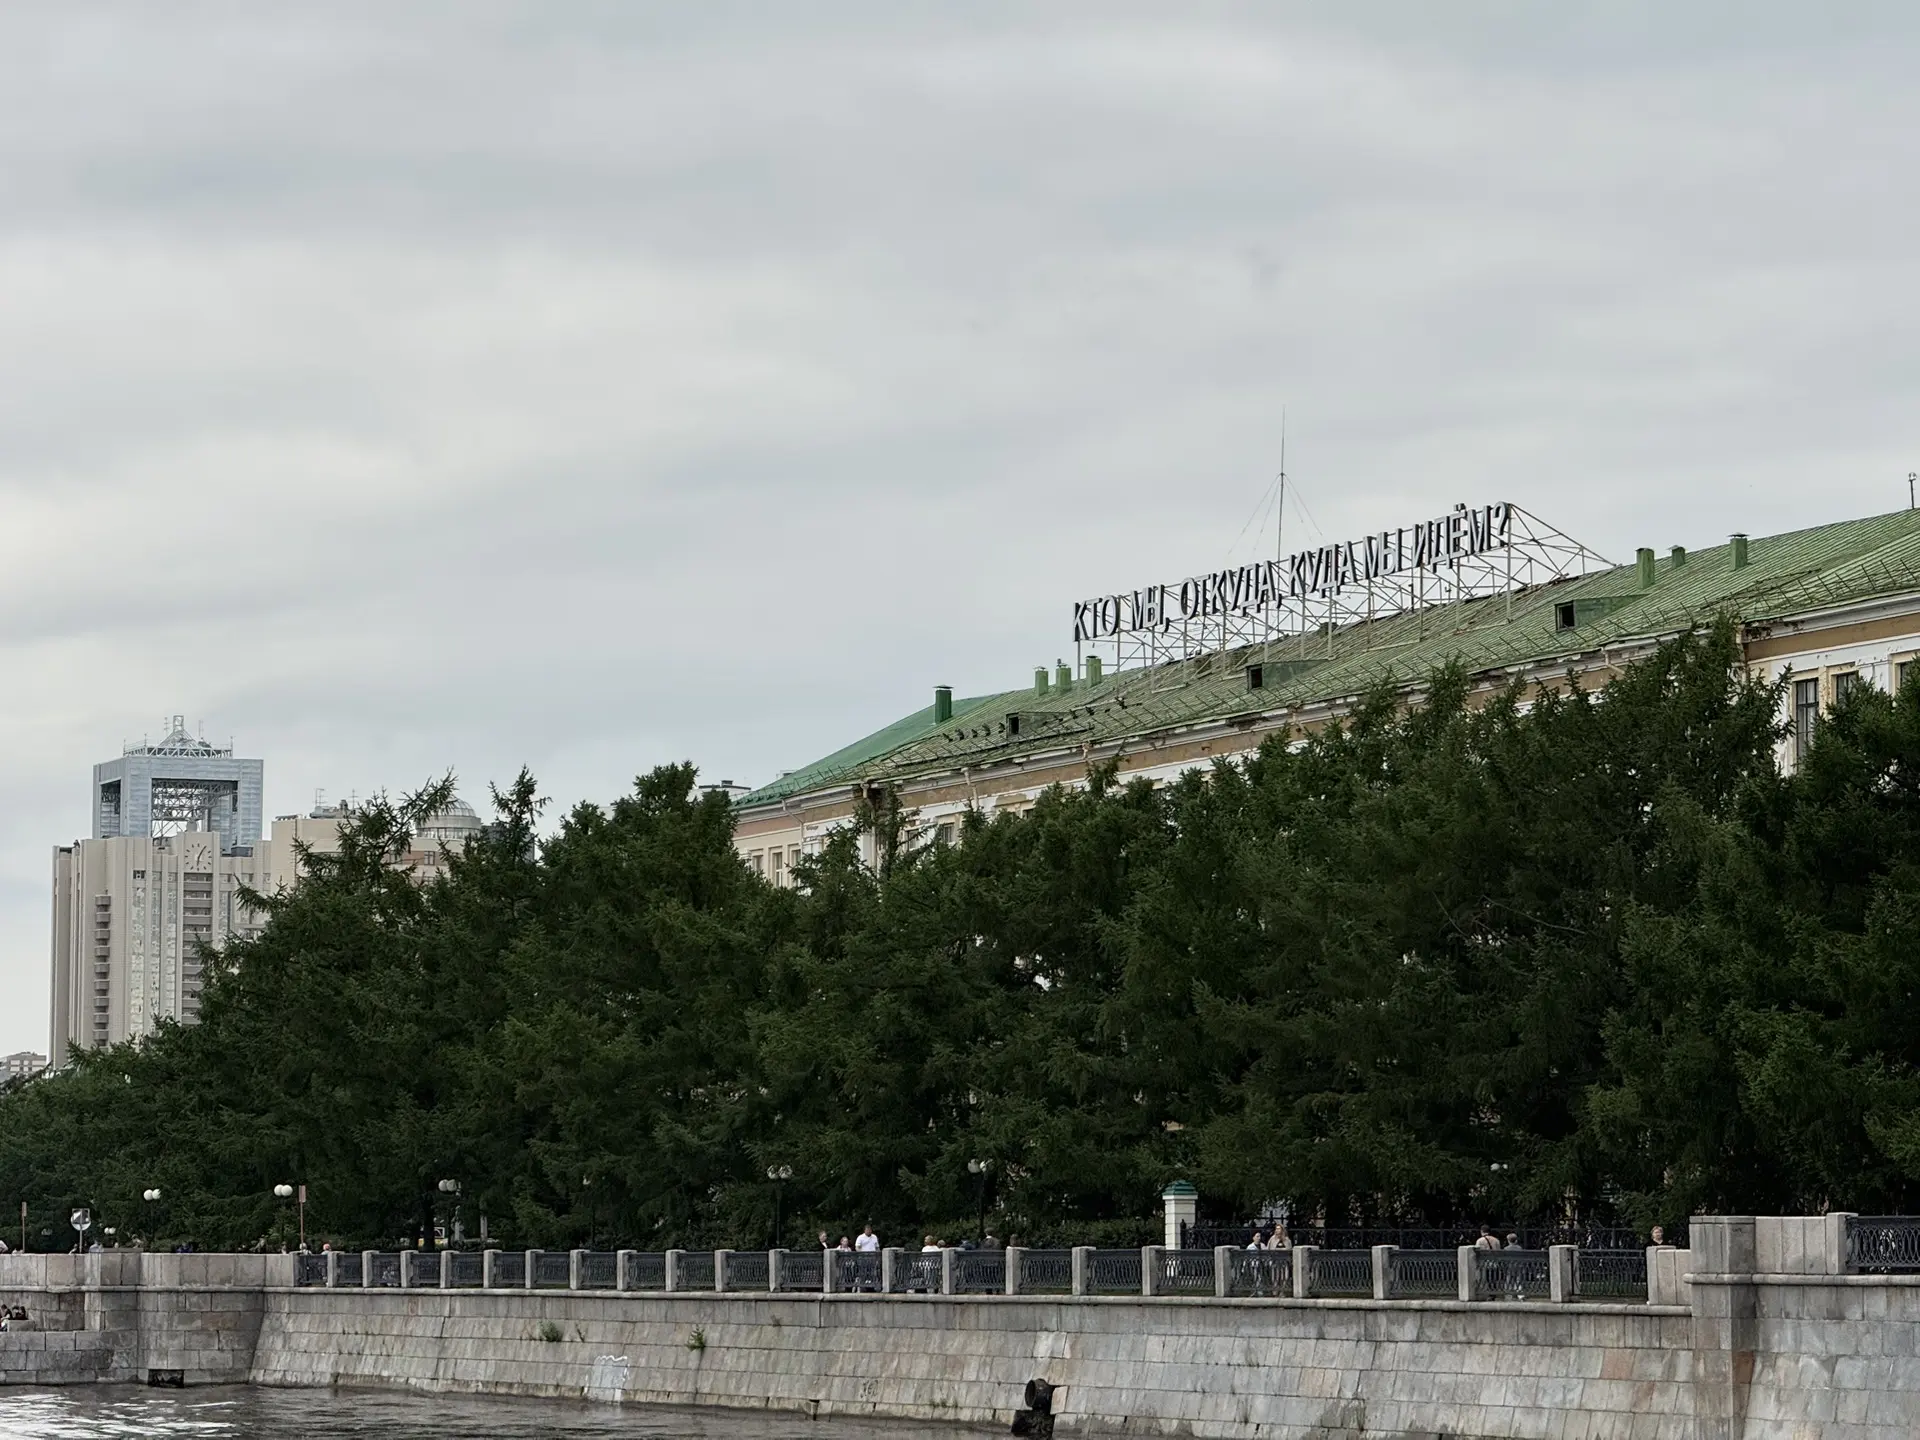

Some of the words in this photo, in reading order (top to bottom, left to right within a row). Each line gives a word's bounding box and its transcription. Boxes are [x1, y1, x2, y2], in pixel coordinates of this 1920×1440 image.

[1072, 595, 1119, 642] КТО
[1130, 584, 1170, 634] МЫ,
[1179, 560, 1282, 620] ОТКУДА,
[1288, 541, 1358, 599] КУДА
[1362, 528, 1402, 580] МЫ
[1411, 501, 1510, 574] ИДЁМ?
